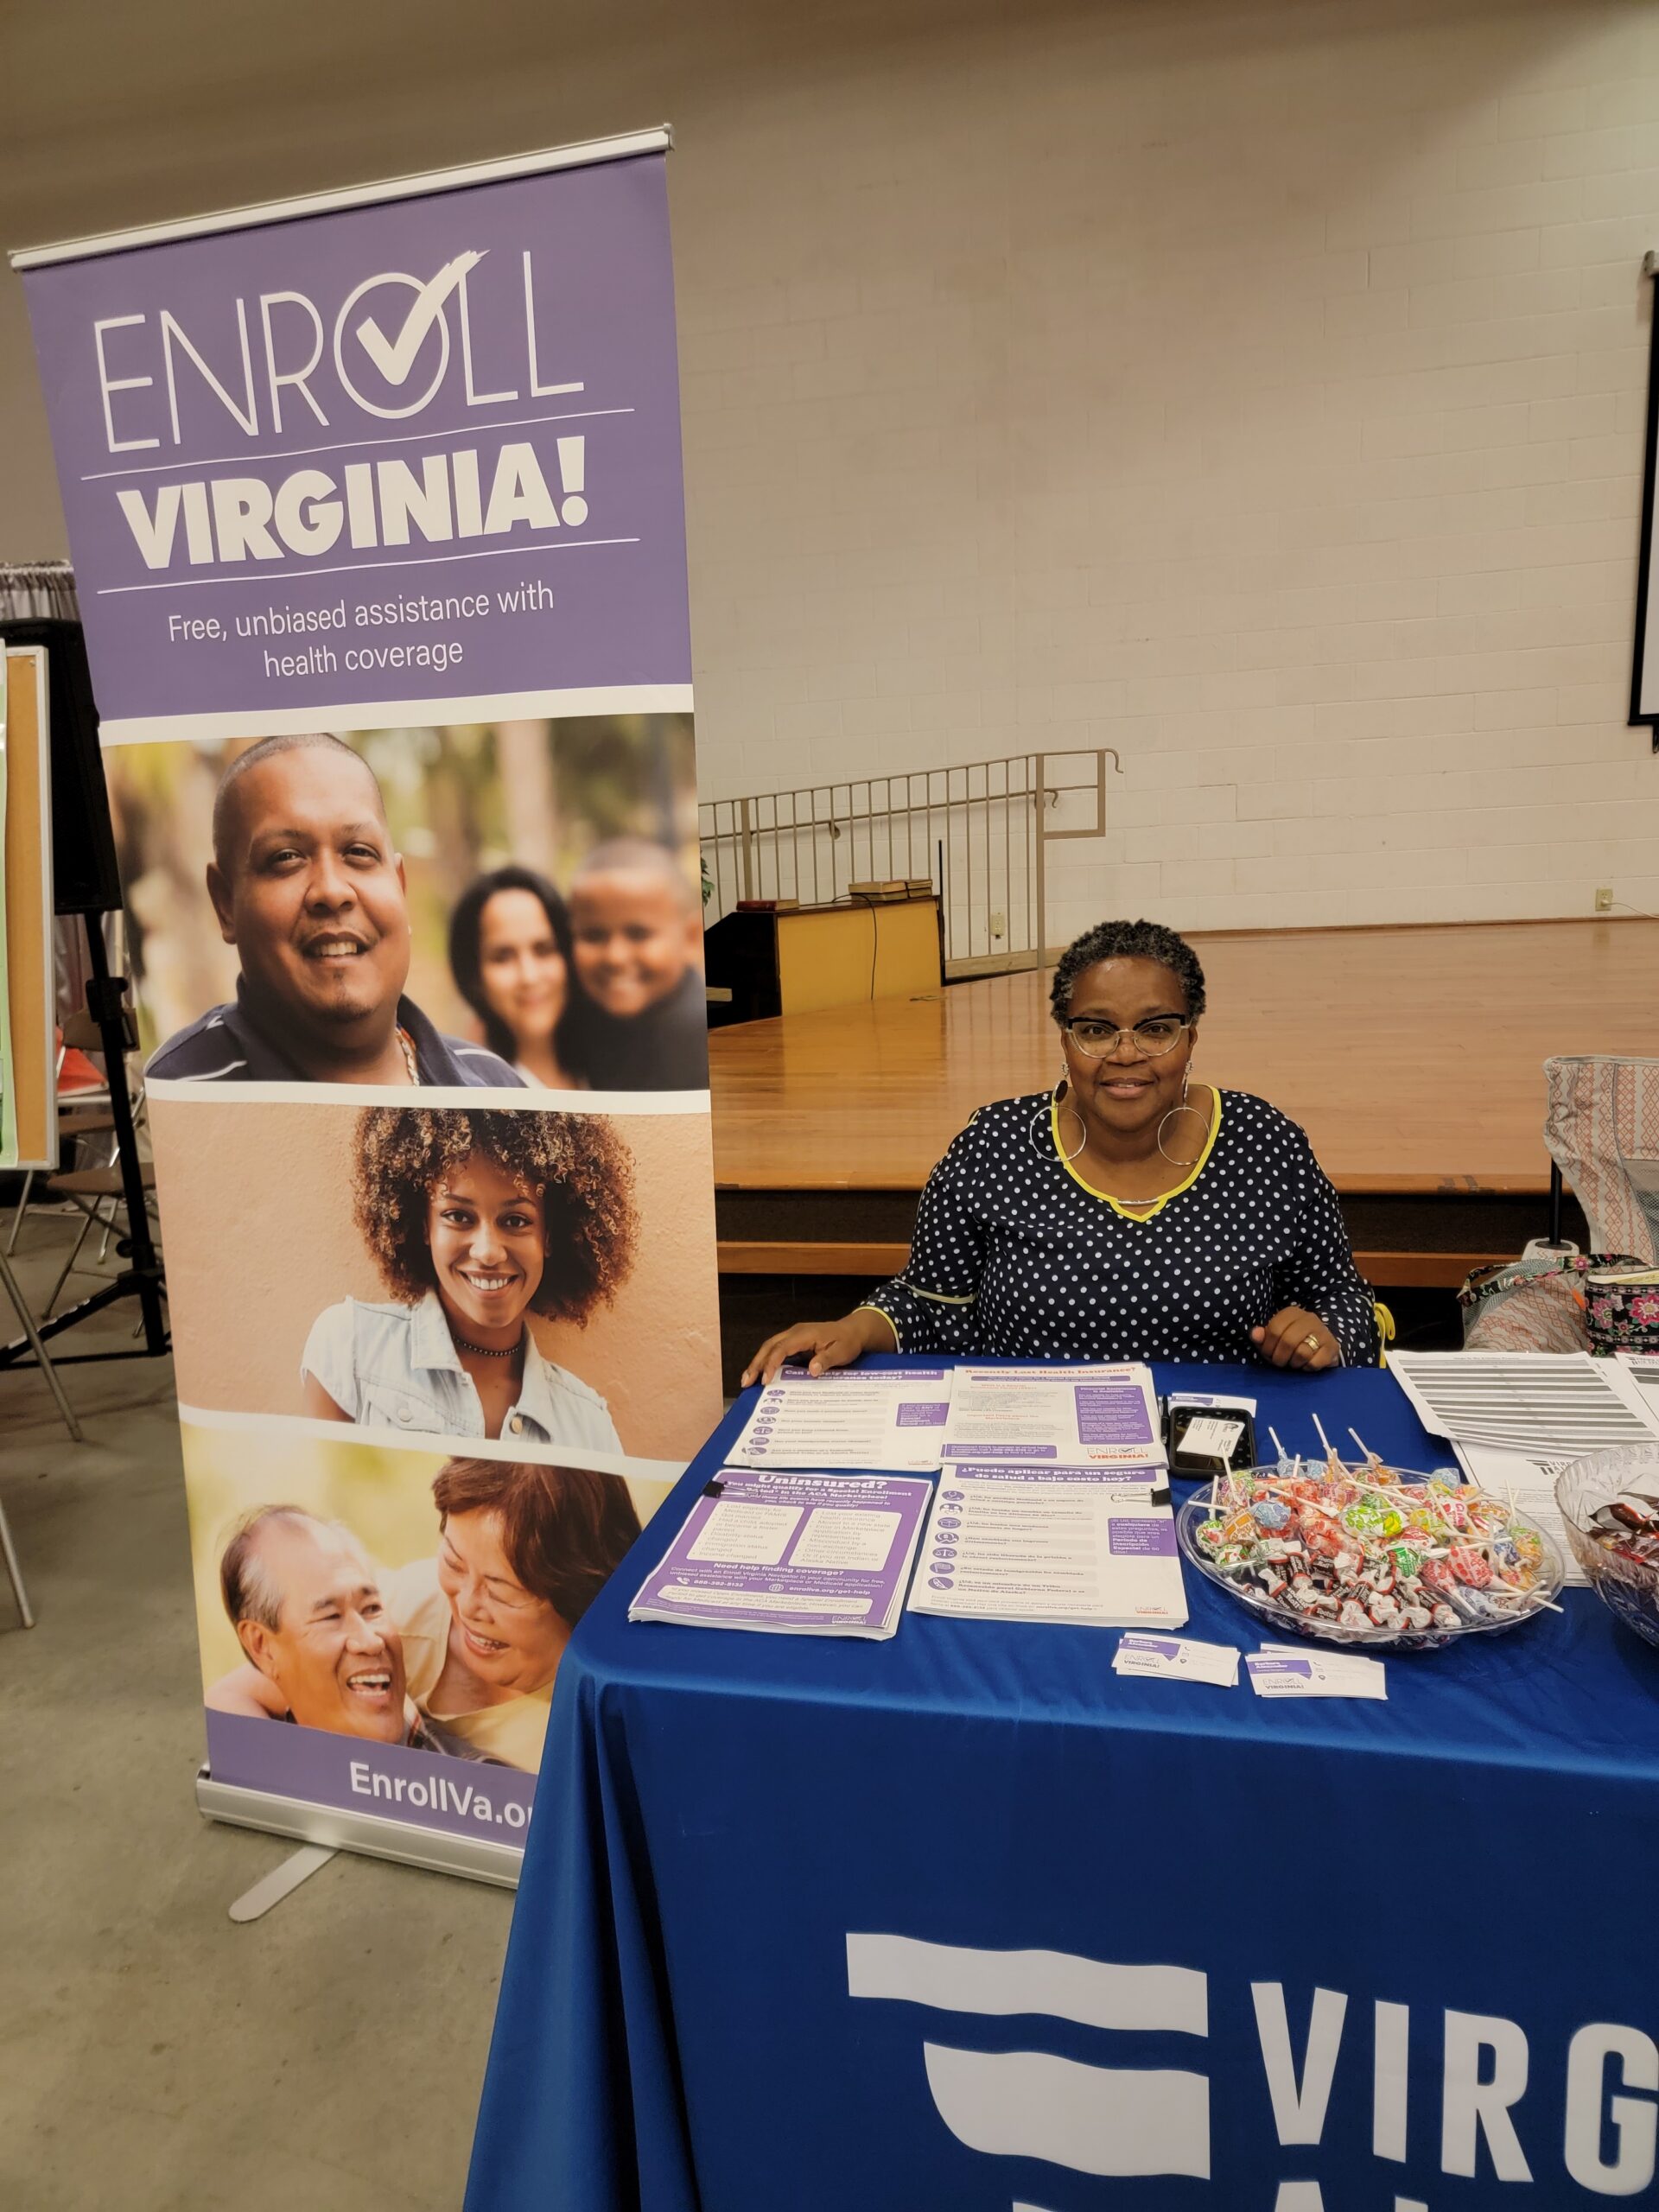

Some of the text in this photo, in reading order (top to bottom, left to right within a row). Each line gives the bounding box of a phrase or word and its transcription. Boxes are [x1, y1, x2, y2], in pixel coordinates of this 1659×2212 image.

[94, 249, 584, 453] ENROLL
[116, 435, 588, 570] VIRGINIA!
[168, 581, 554, 642] Free, unbiased assistance with
[264, 641, 463, 677] health coverage
[758, 1474, 888, 1489] Uninsured?
[1250, 1981, 1659, 2196] VIRG
